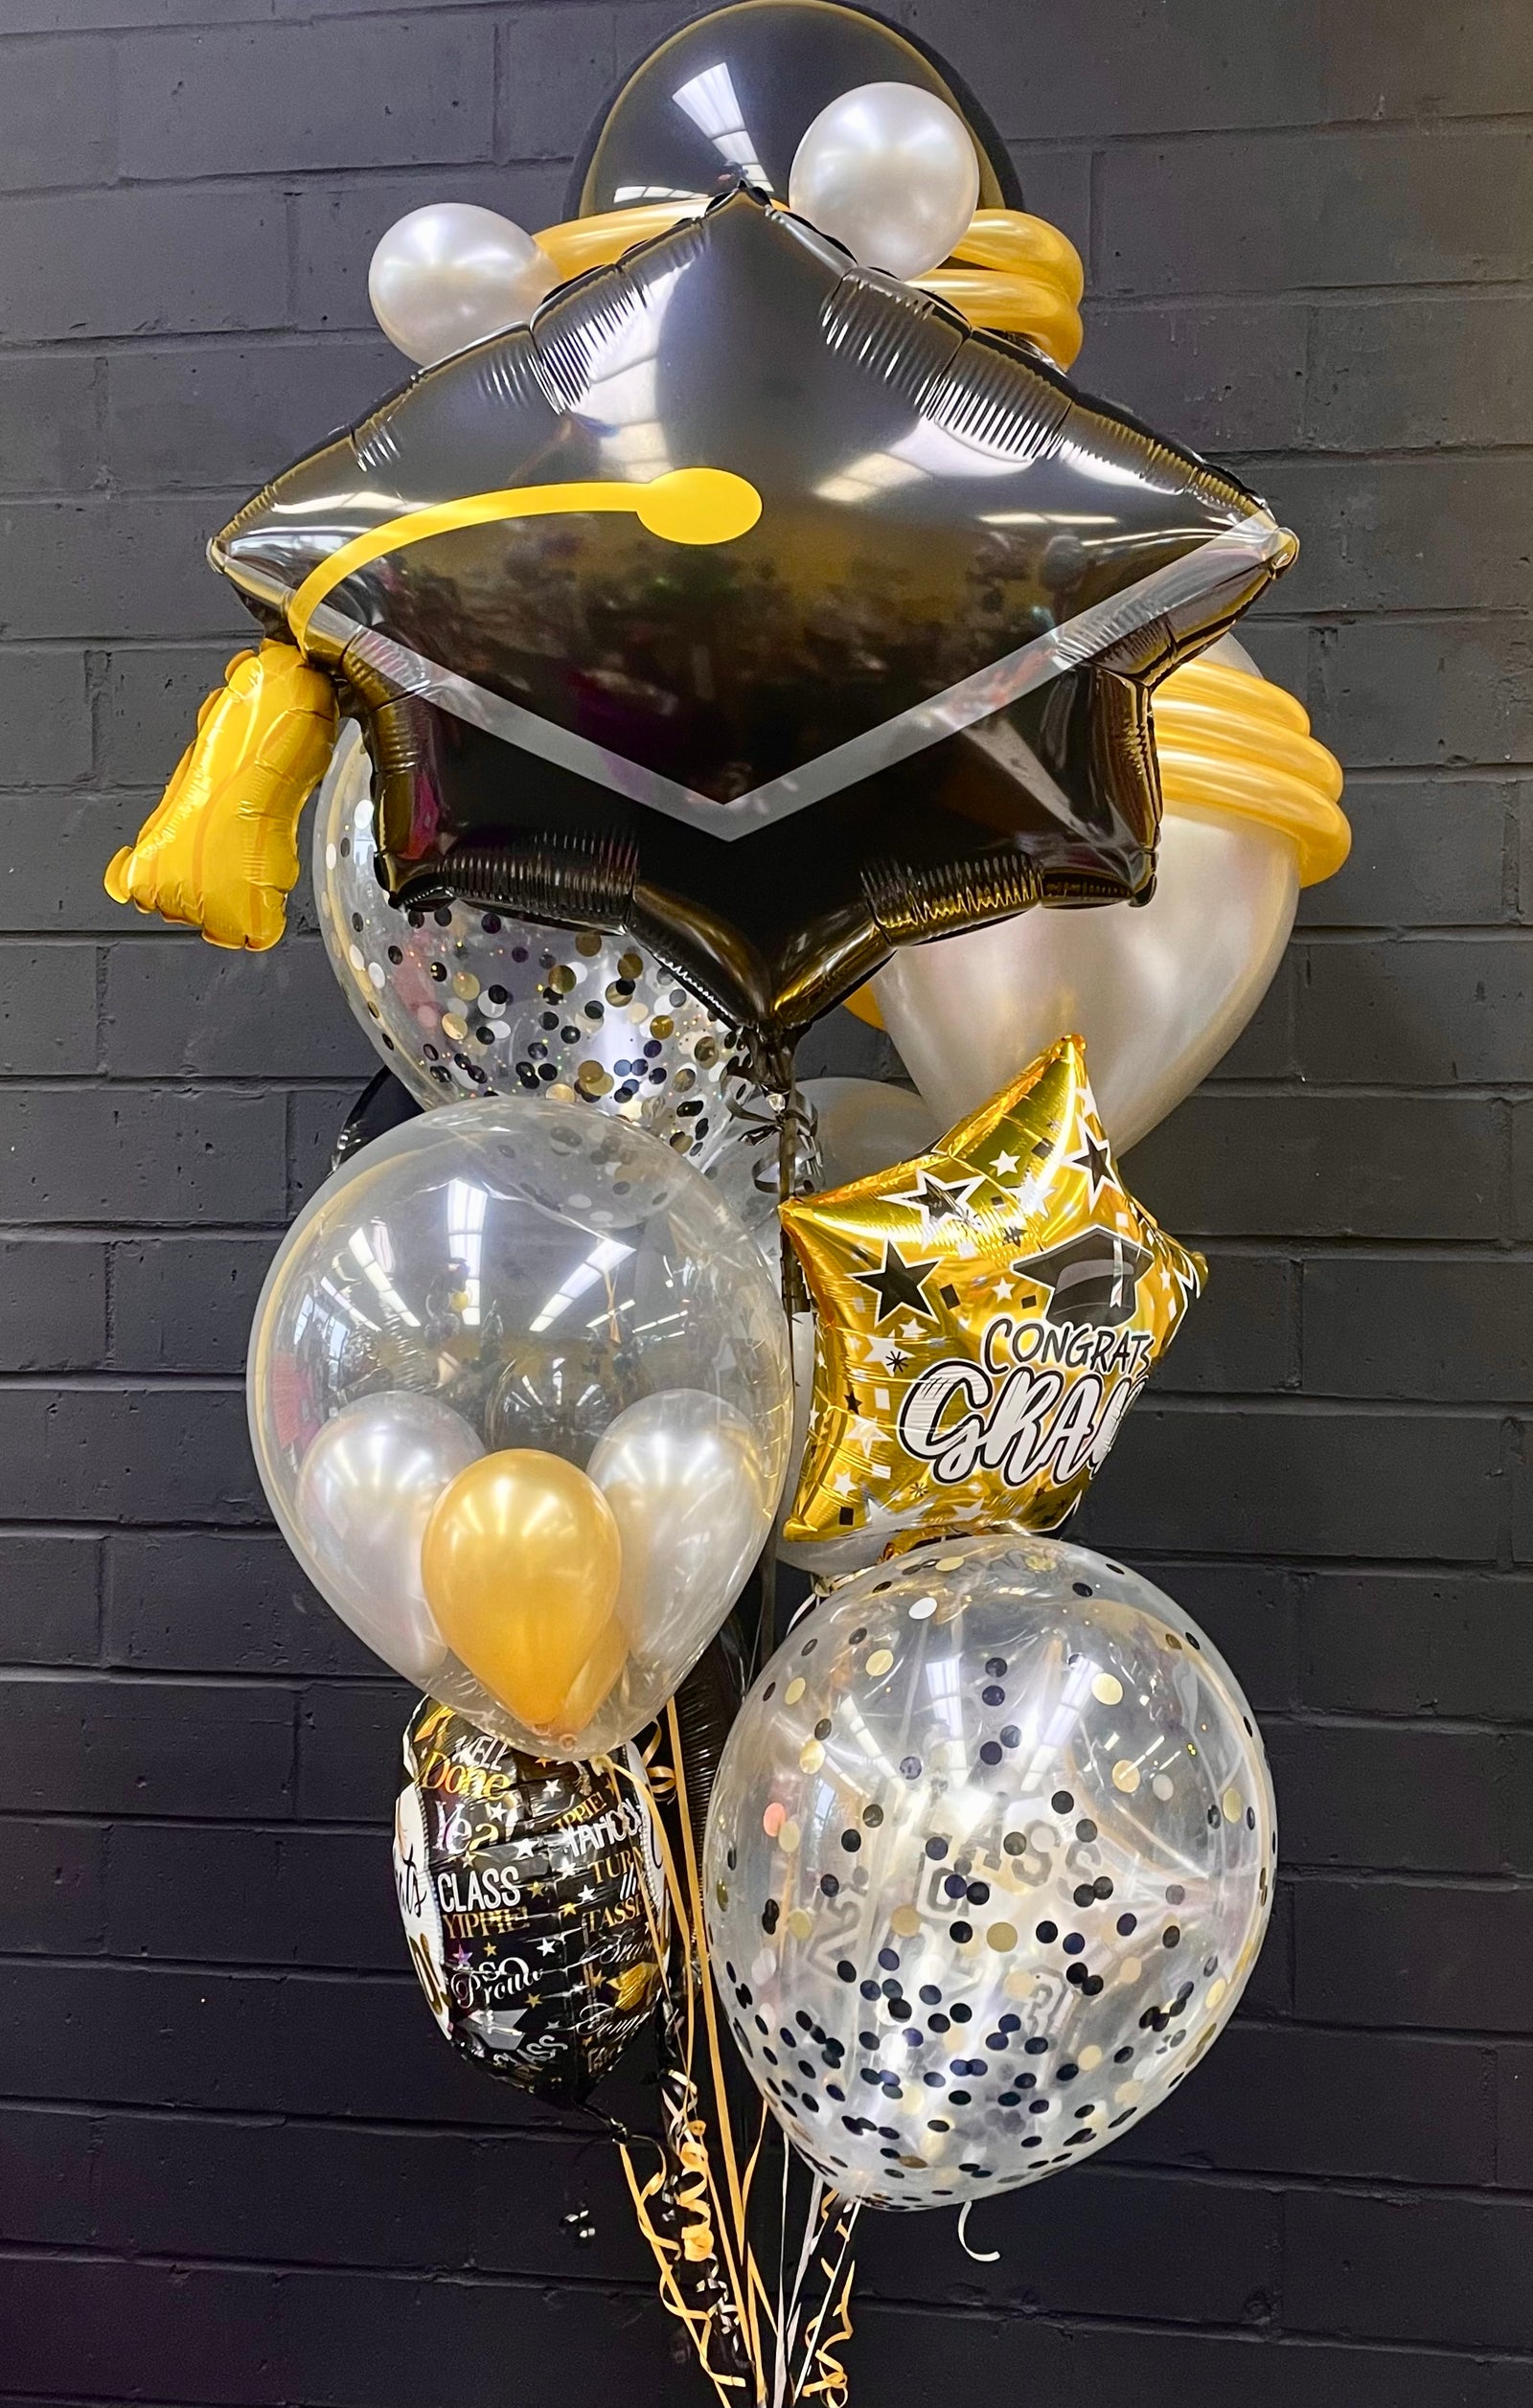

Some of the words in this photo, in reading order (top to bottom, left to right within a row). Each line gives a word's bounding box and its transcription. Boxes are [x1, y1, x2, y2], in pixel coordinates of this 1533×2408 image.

[983, 1317, 1155, 1378] CONGRATS
[437, 1865, 521, 1913] CLASS
[442, 1905, 531, 1940] YIPPIE!
